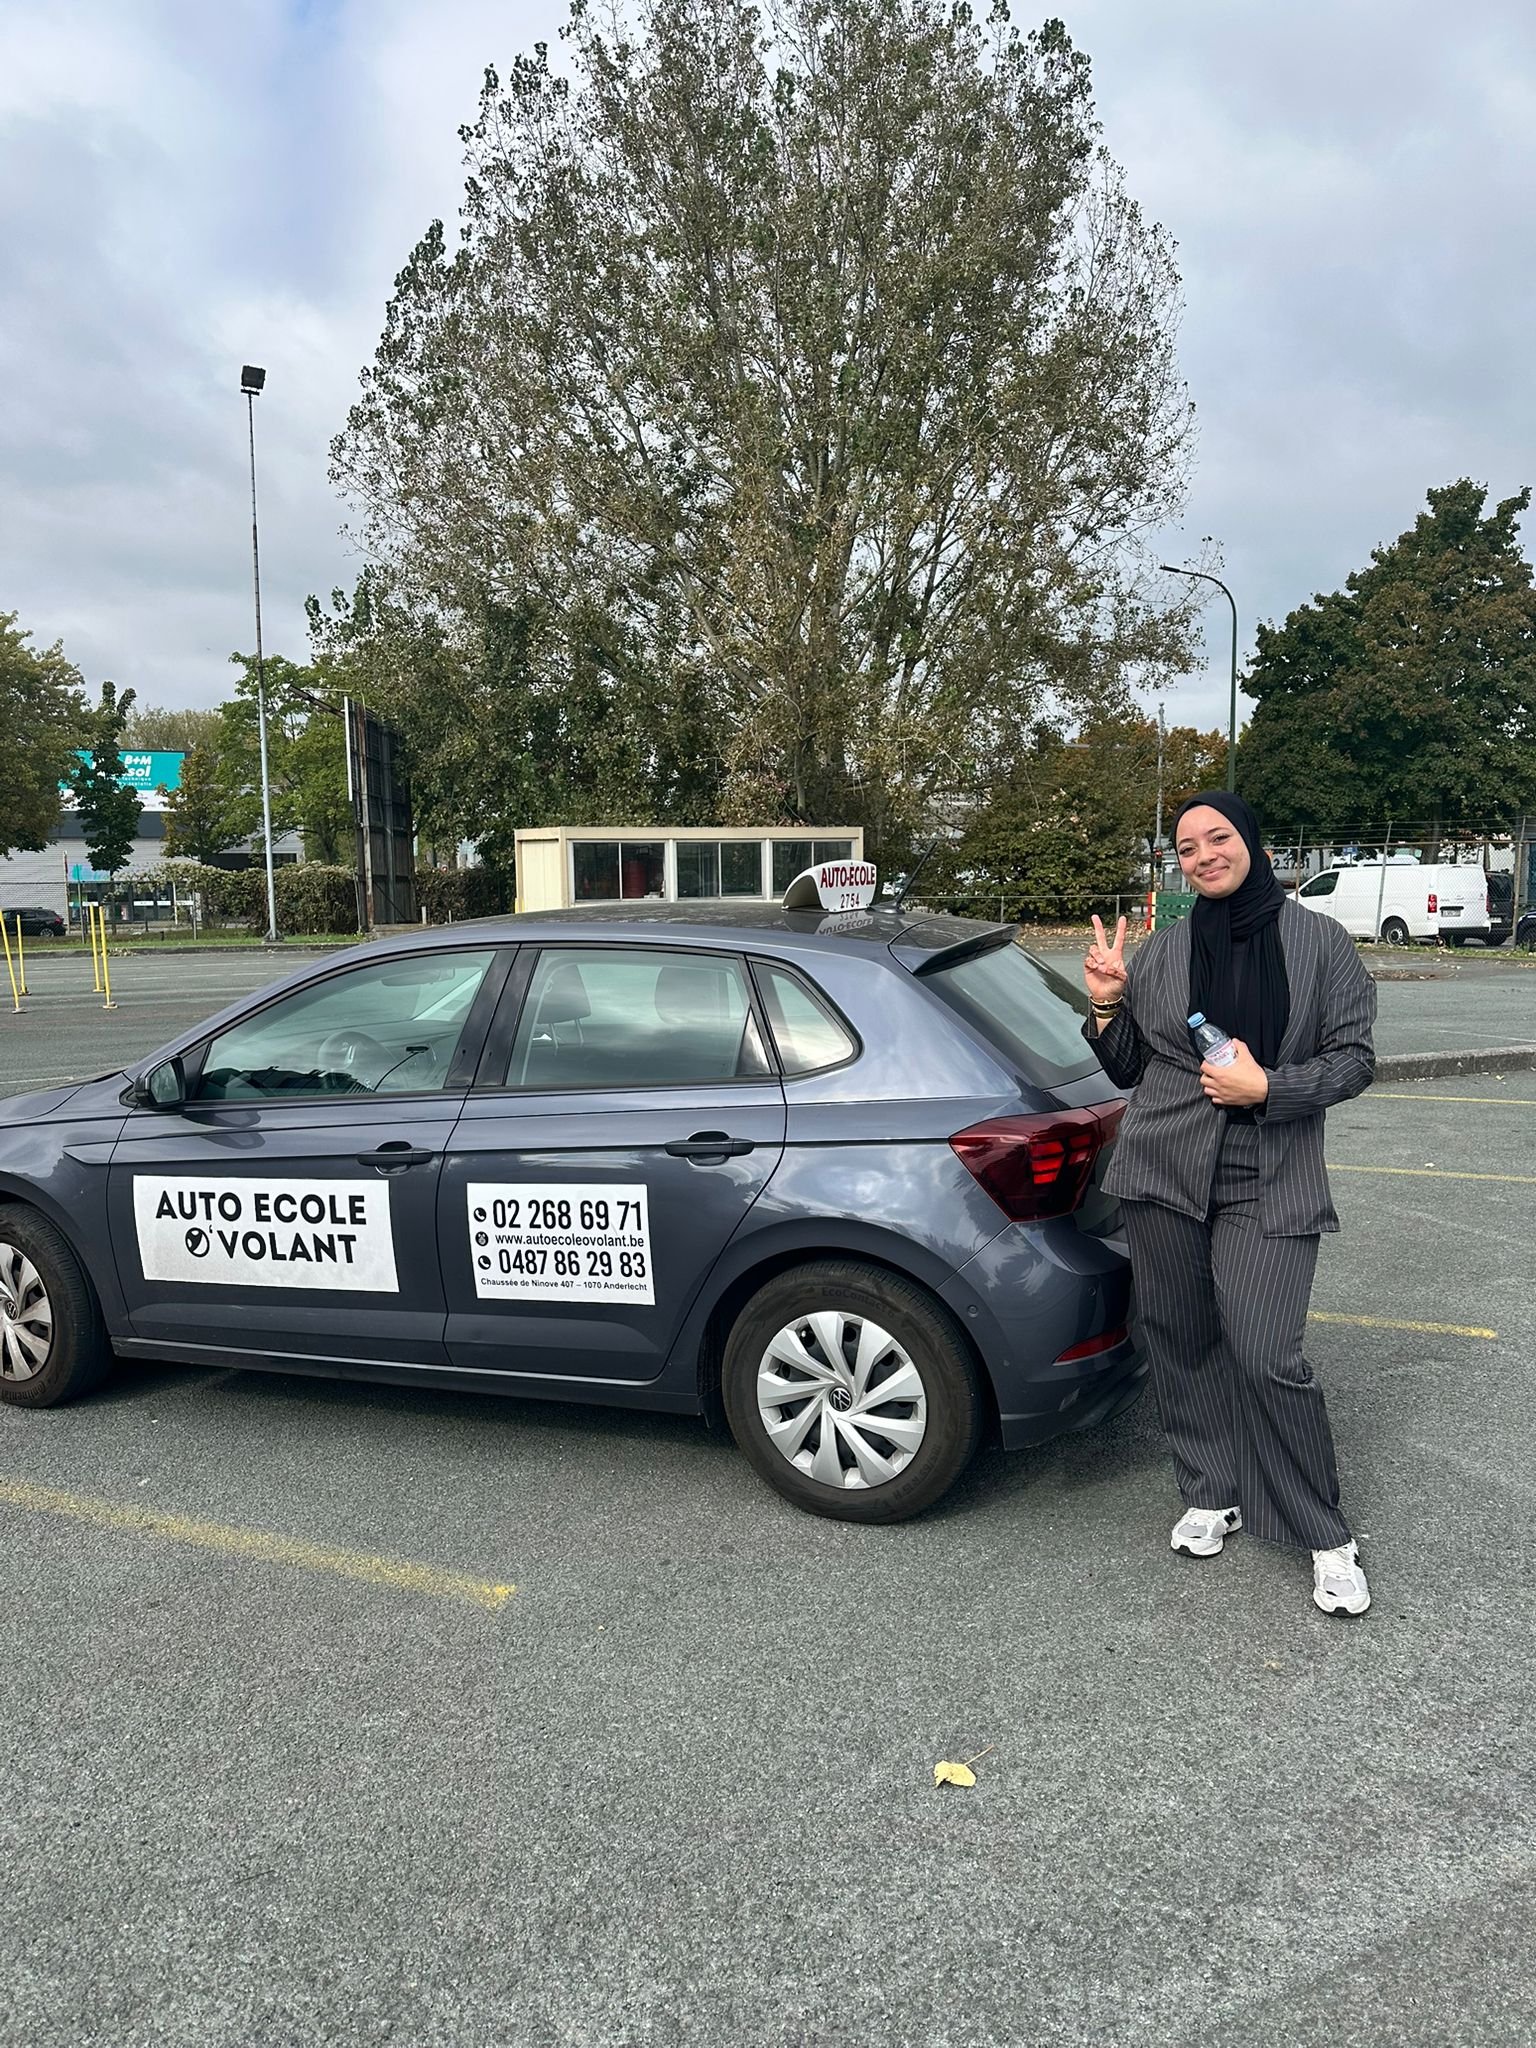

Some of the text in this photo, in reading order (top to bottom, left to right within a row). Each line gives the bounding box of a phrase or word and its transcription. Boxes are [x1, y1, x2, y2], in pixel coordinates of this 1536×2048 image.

[124, 755, 152, 766] B+M
[820, 866, 875, 888] AUTO-ECOLE
[840, 893, 860, 909] 2754
[155, 1190, 367, 1225] AUTO ECOLE
[492, 1199, 642, 1231] 02 268 69 71
[495, 1233, 644, 1247] www.autoecoleovolant.be
[499, 1249, 646, 1278] 0487 86 29 83
[481, 1278, 519, 1287] Chaussée
[519, 1279, 530, 1287] de
[531, 1280, 559, 1288] Ninove
[560, 1280, 574, 1288] 407
[583, 1281, 602, 1289] 1070
[603, 1282, 648, 1291] Anderlecht
